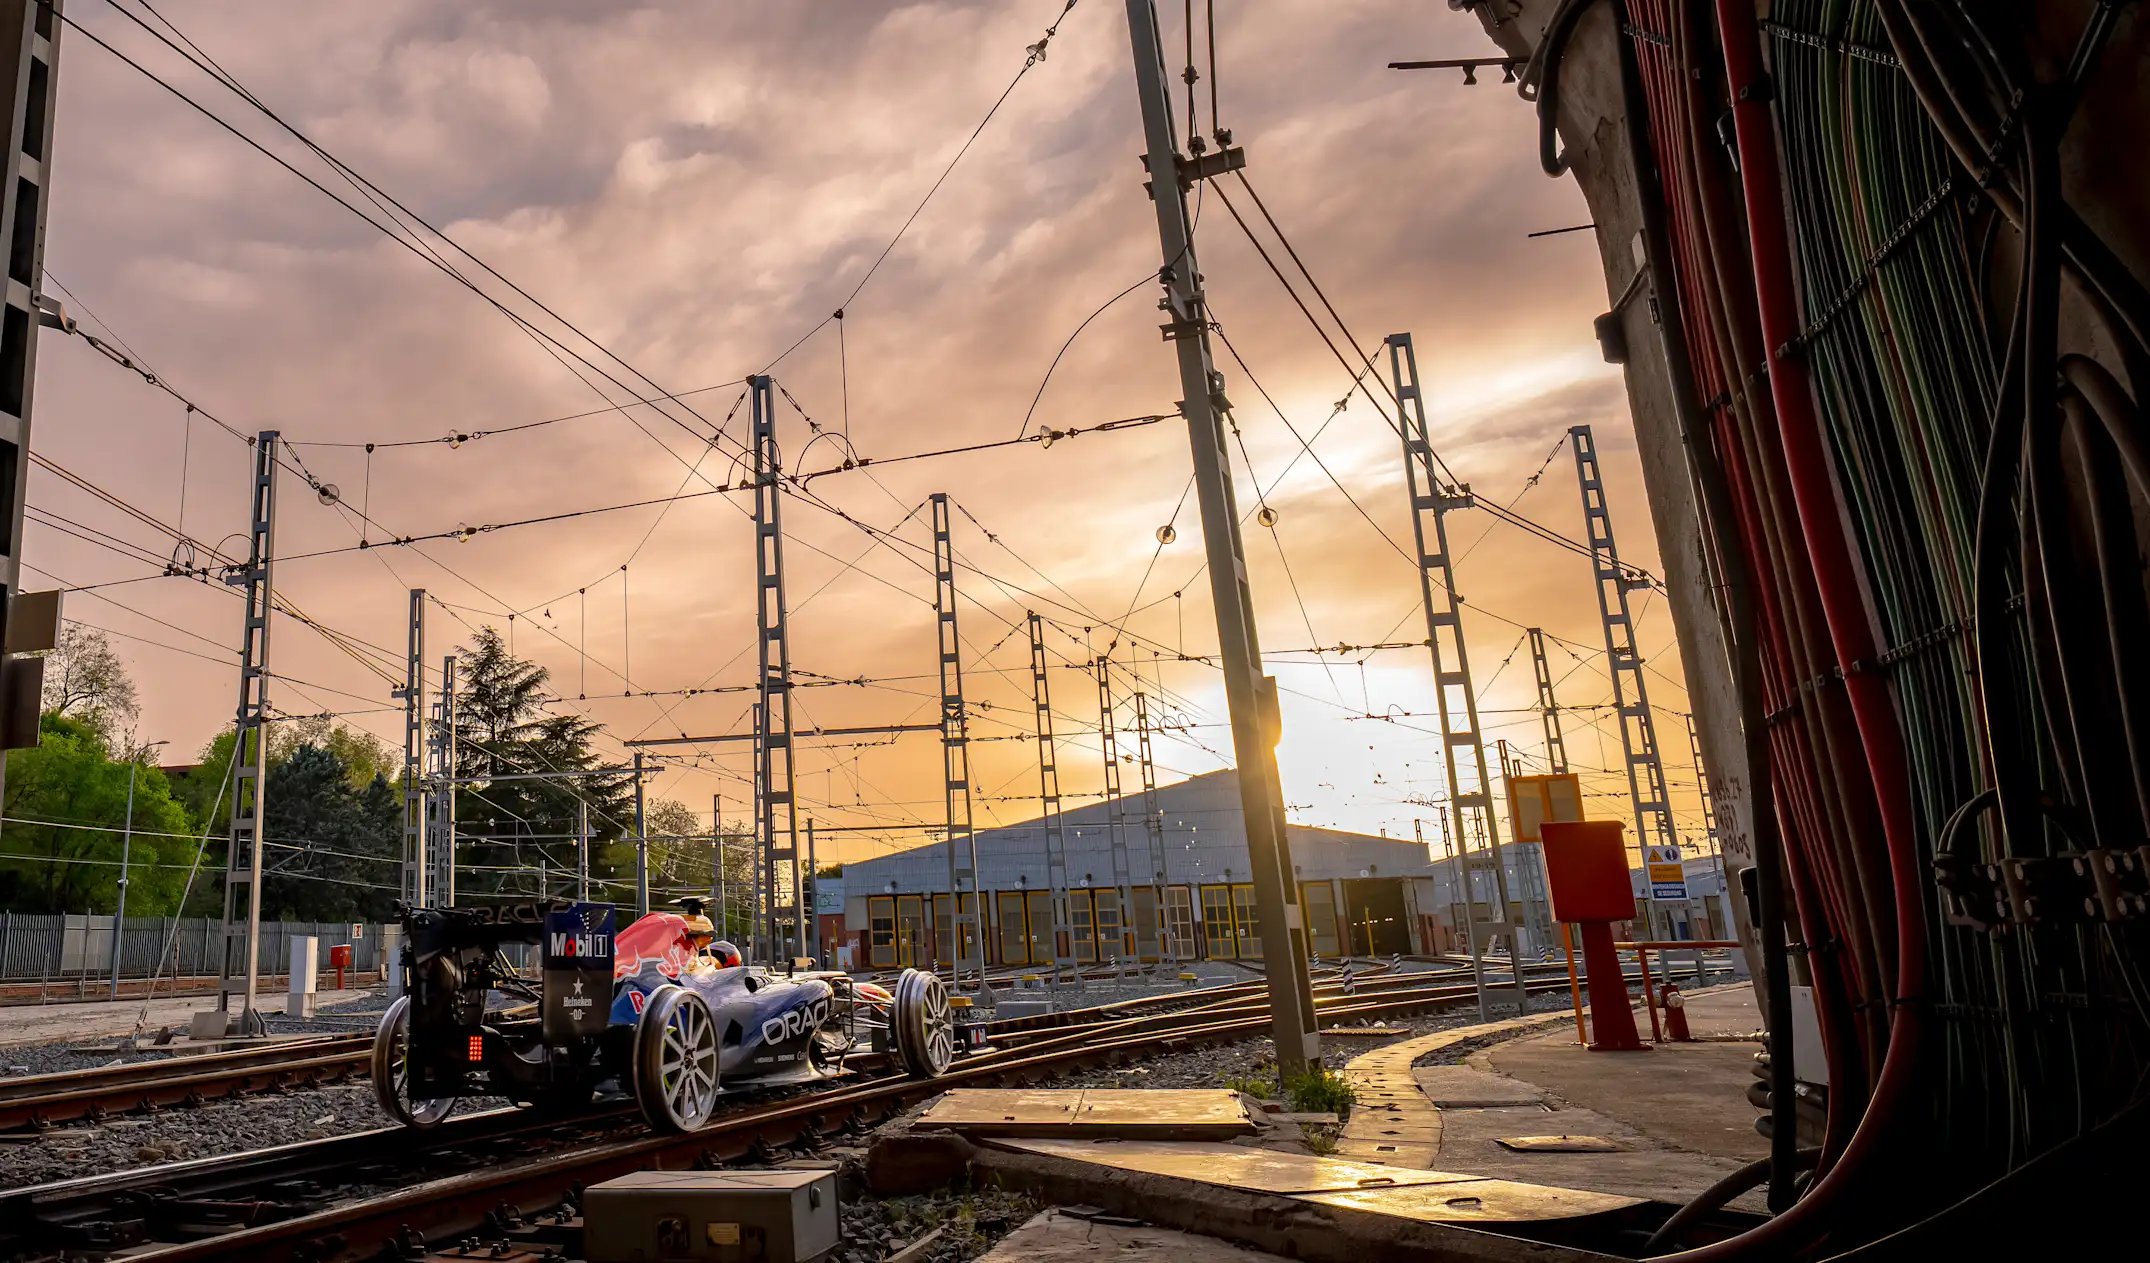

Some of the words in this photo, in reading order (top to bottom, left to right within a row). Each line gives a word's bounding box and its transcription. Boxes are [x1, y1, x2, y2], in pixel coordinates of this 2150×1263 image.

[550, 932, 593, 957] Mobil
[596, 936, 606, 956] 1
[563, 996, 592, 1007] Heineken
